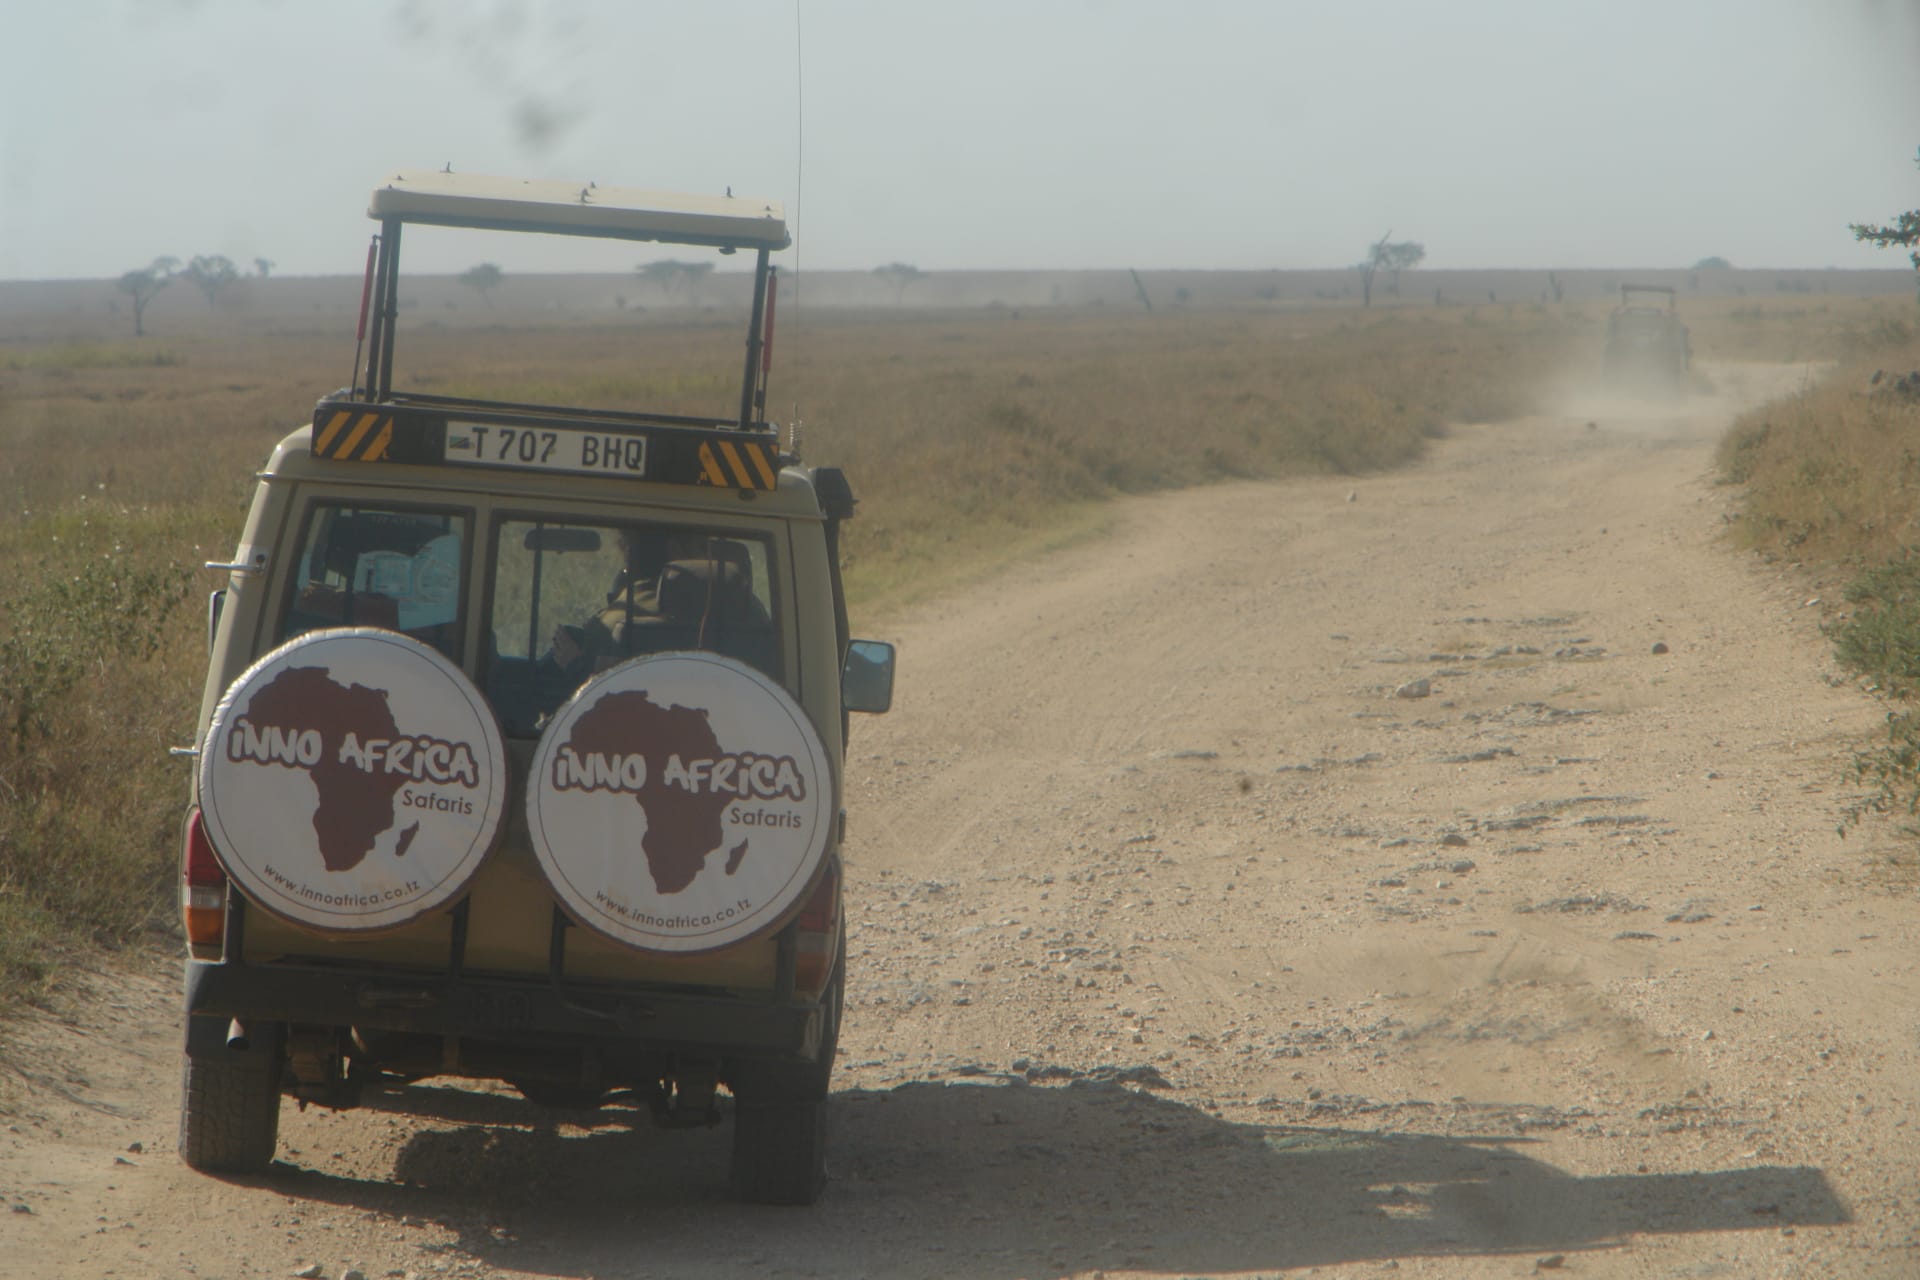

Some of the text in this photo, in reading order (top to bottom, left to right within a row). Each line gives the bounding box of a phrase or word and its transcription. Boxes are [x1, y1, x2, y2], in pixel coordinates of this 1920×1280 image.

[472, 426, 643, 470] T 707 BHQ
[402, 789, 474, 815] Safaris
[729, 807, 802, 829] Safaris
[263, 864, 420, 907] www.innoafrica.co.tz
[595, 890, 752, 929] www.innoafrica.co.tz
